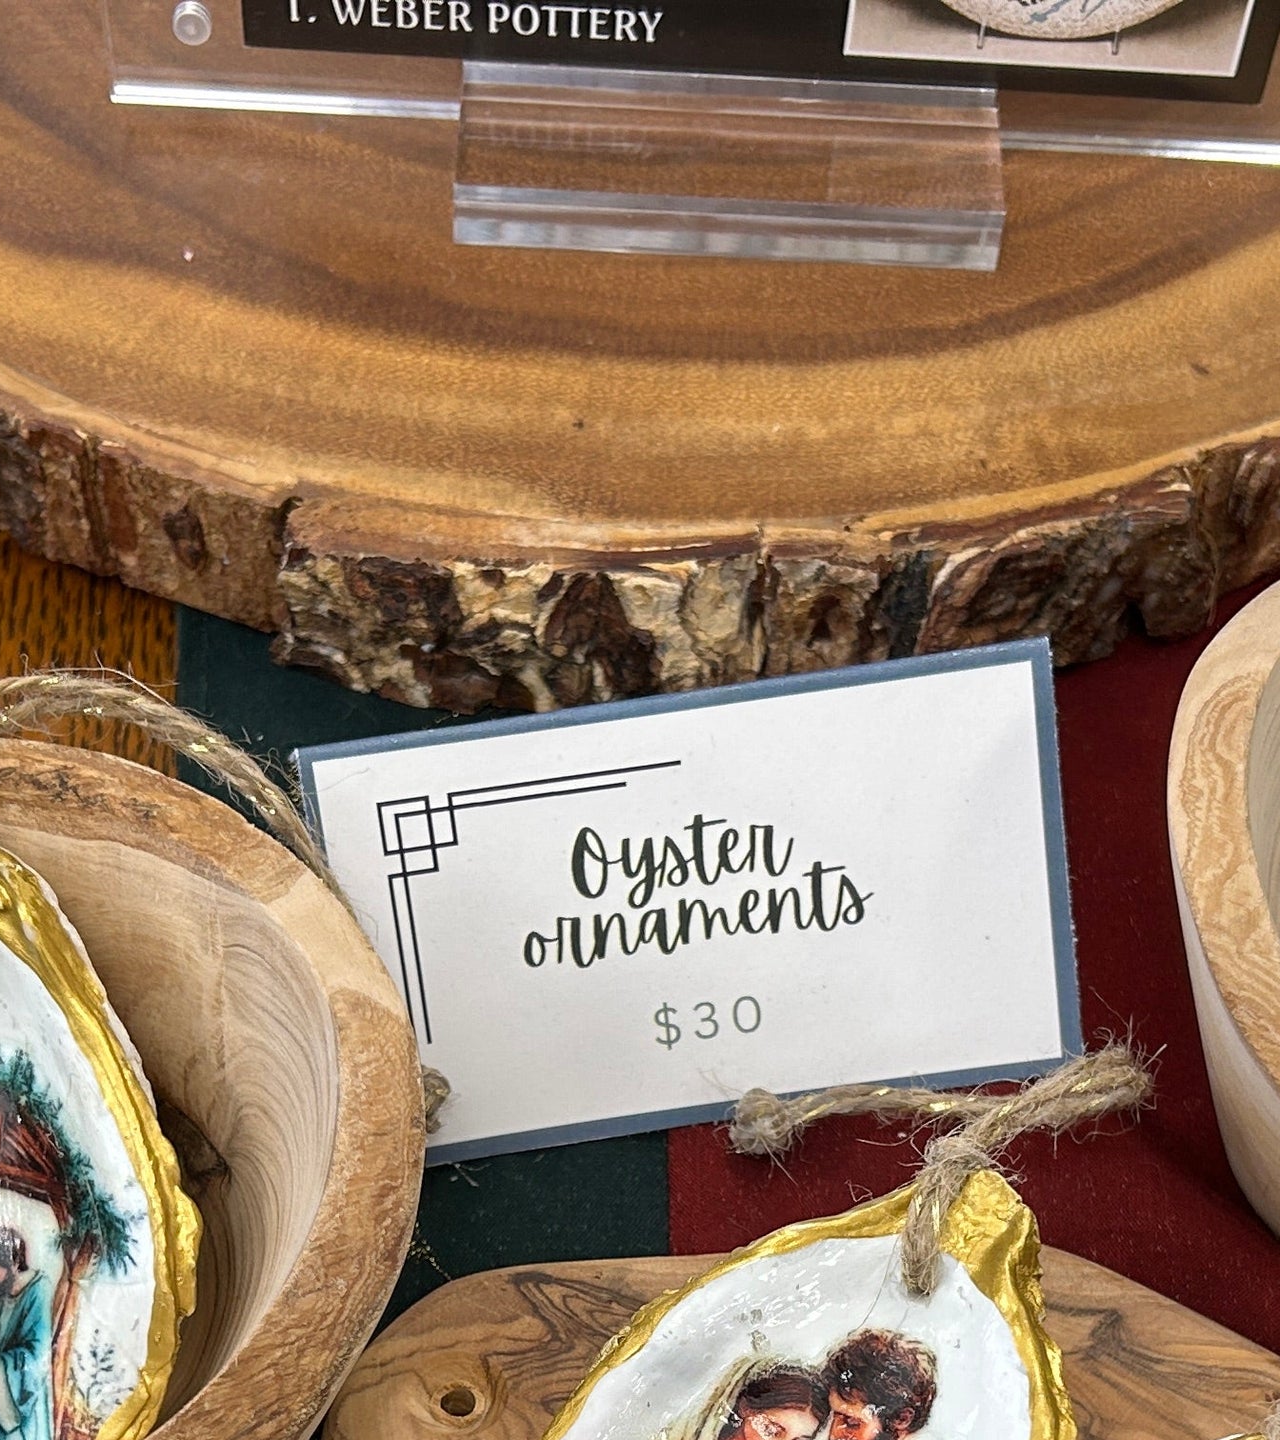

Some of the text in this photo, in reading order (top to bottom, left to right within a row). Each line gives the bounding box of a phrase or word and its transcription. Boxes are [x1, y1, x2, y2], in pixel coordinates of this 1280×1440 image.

[330, 0, 474, 33] WEBER
[487, 2, 664, 44] POTTERY
[570, 813, 795, 909] Oyster
[522, 860, 875, 970] ornaments
[652, 994, 763, 1051] $30
